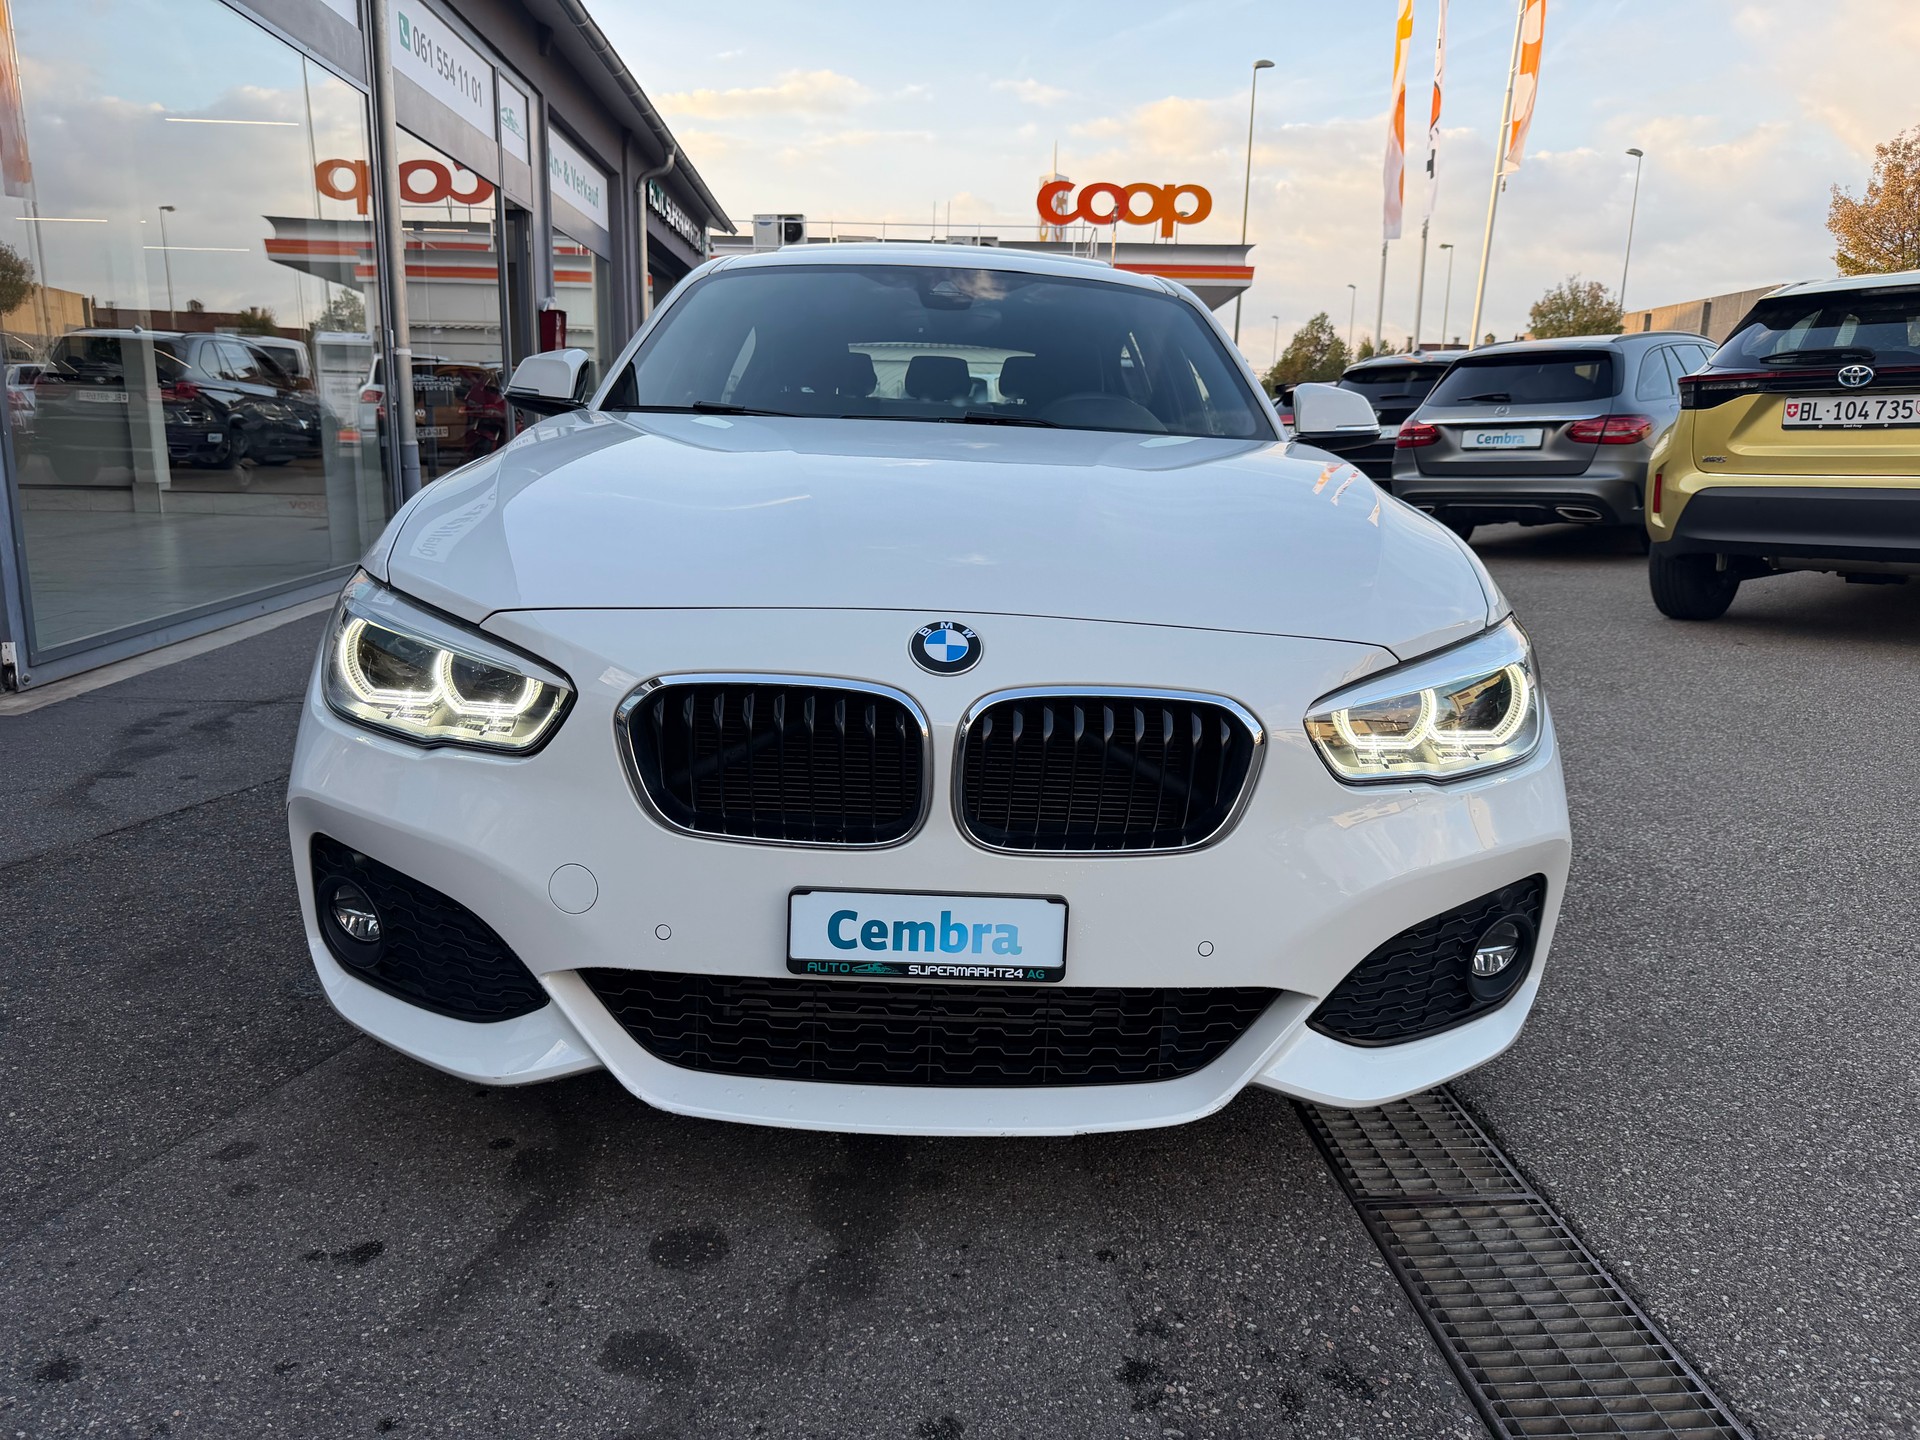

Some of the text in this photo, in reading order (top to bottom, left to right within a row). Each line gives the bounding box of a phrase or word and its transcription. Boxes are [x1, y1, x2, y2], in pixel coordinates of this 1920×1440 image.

[413, 26, 482, 108] 061 554 11 01
[563, 160, 570, 187] &
[571, 165, 599, 209] Verkauf
[1037, 180, 1212, 239] coop
[1875, 400, 1914, 420] 735
[1476, 433, 1526, 445] Cembra
[918, 621, 977, 639] BMW
[827, 909, 1023, 956] Cembra
[807, 961, 1046, 980] AUTO SUPERMARKT24 AG
